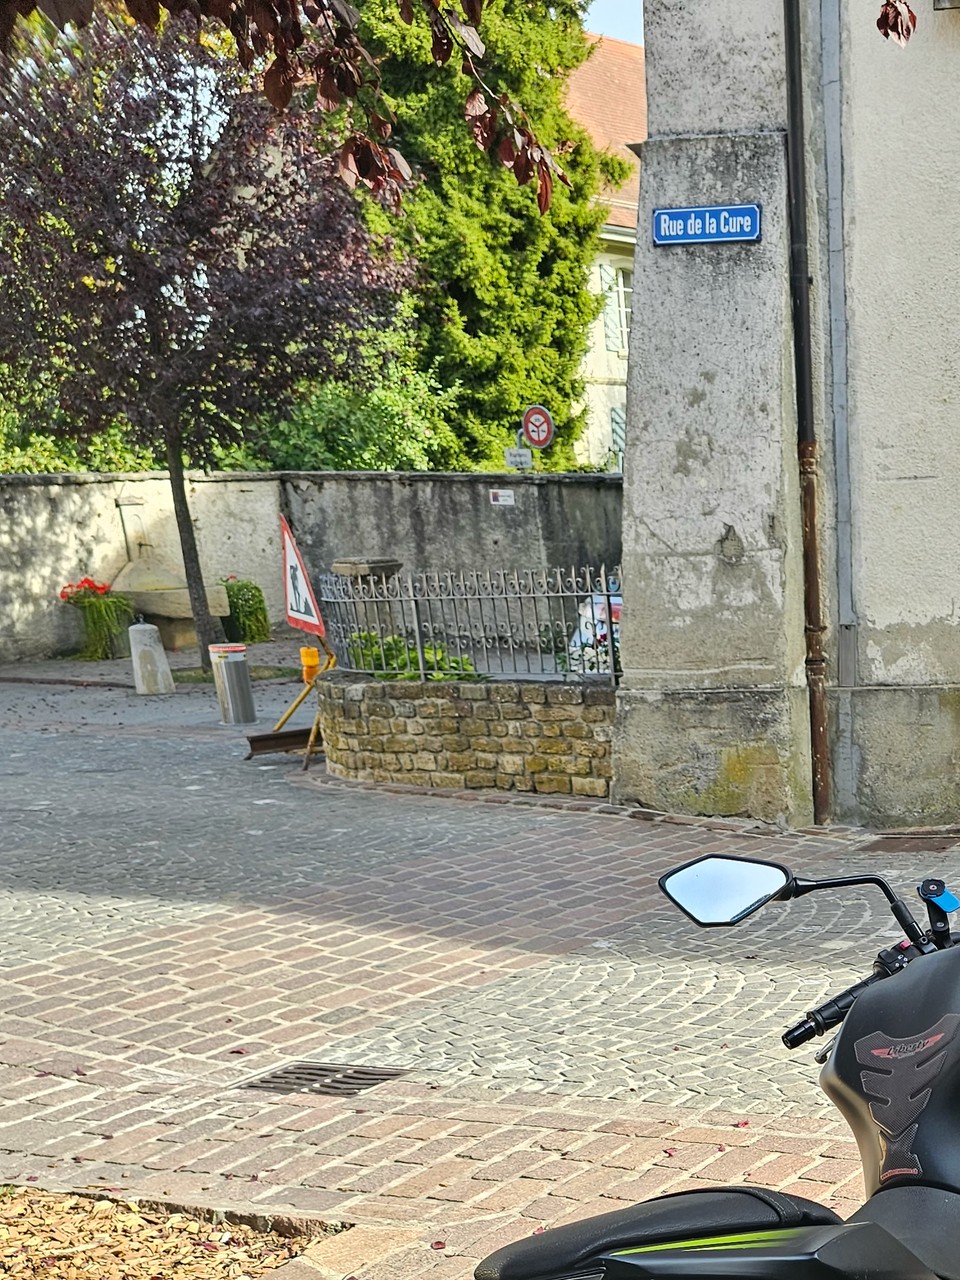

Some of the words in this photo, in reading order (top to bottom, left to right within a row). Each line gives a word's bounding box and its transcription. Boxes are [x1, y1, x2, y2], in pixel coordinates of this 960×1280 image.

[660, 214, 684, 236] Rue
[687, 212, 702, 235] de
[705, 212, 717, 234] la
[720, 211, 752, 233] Cure
